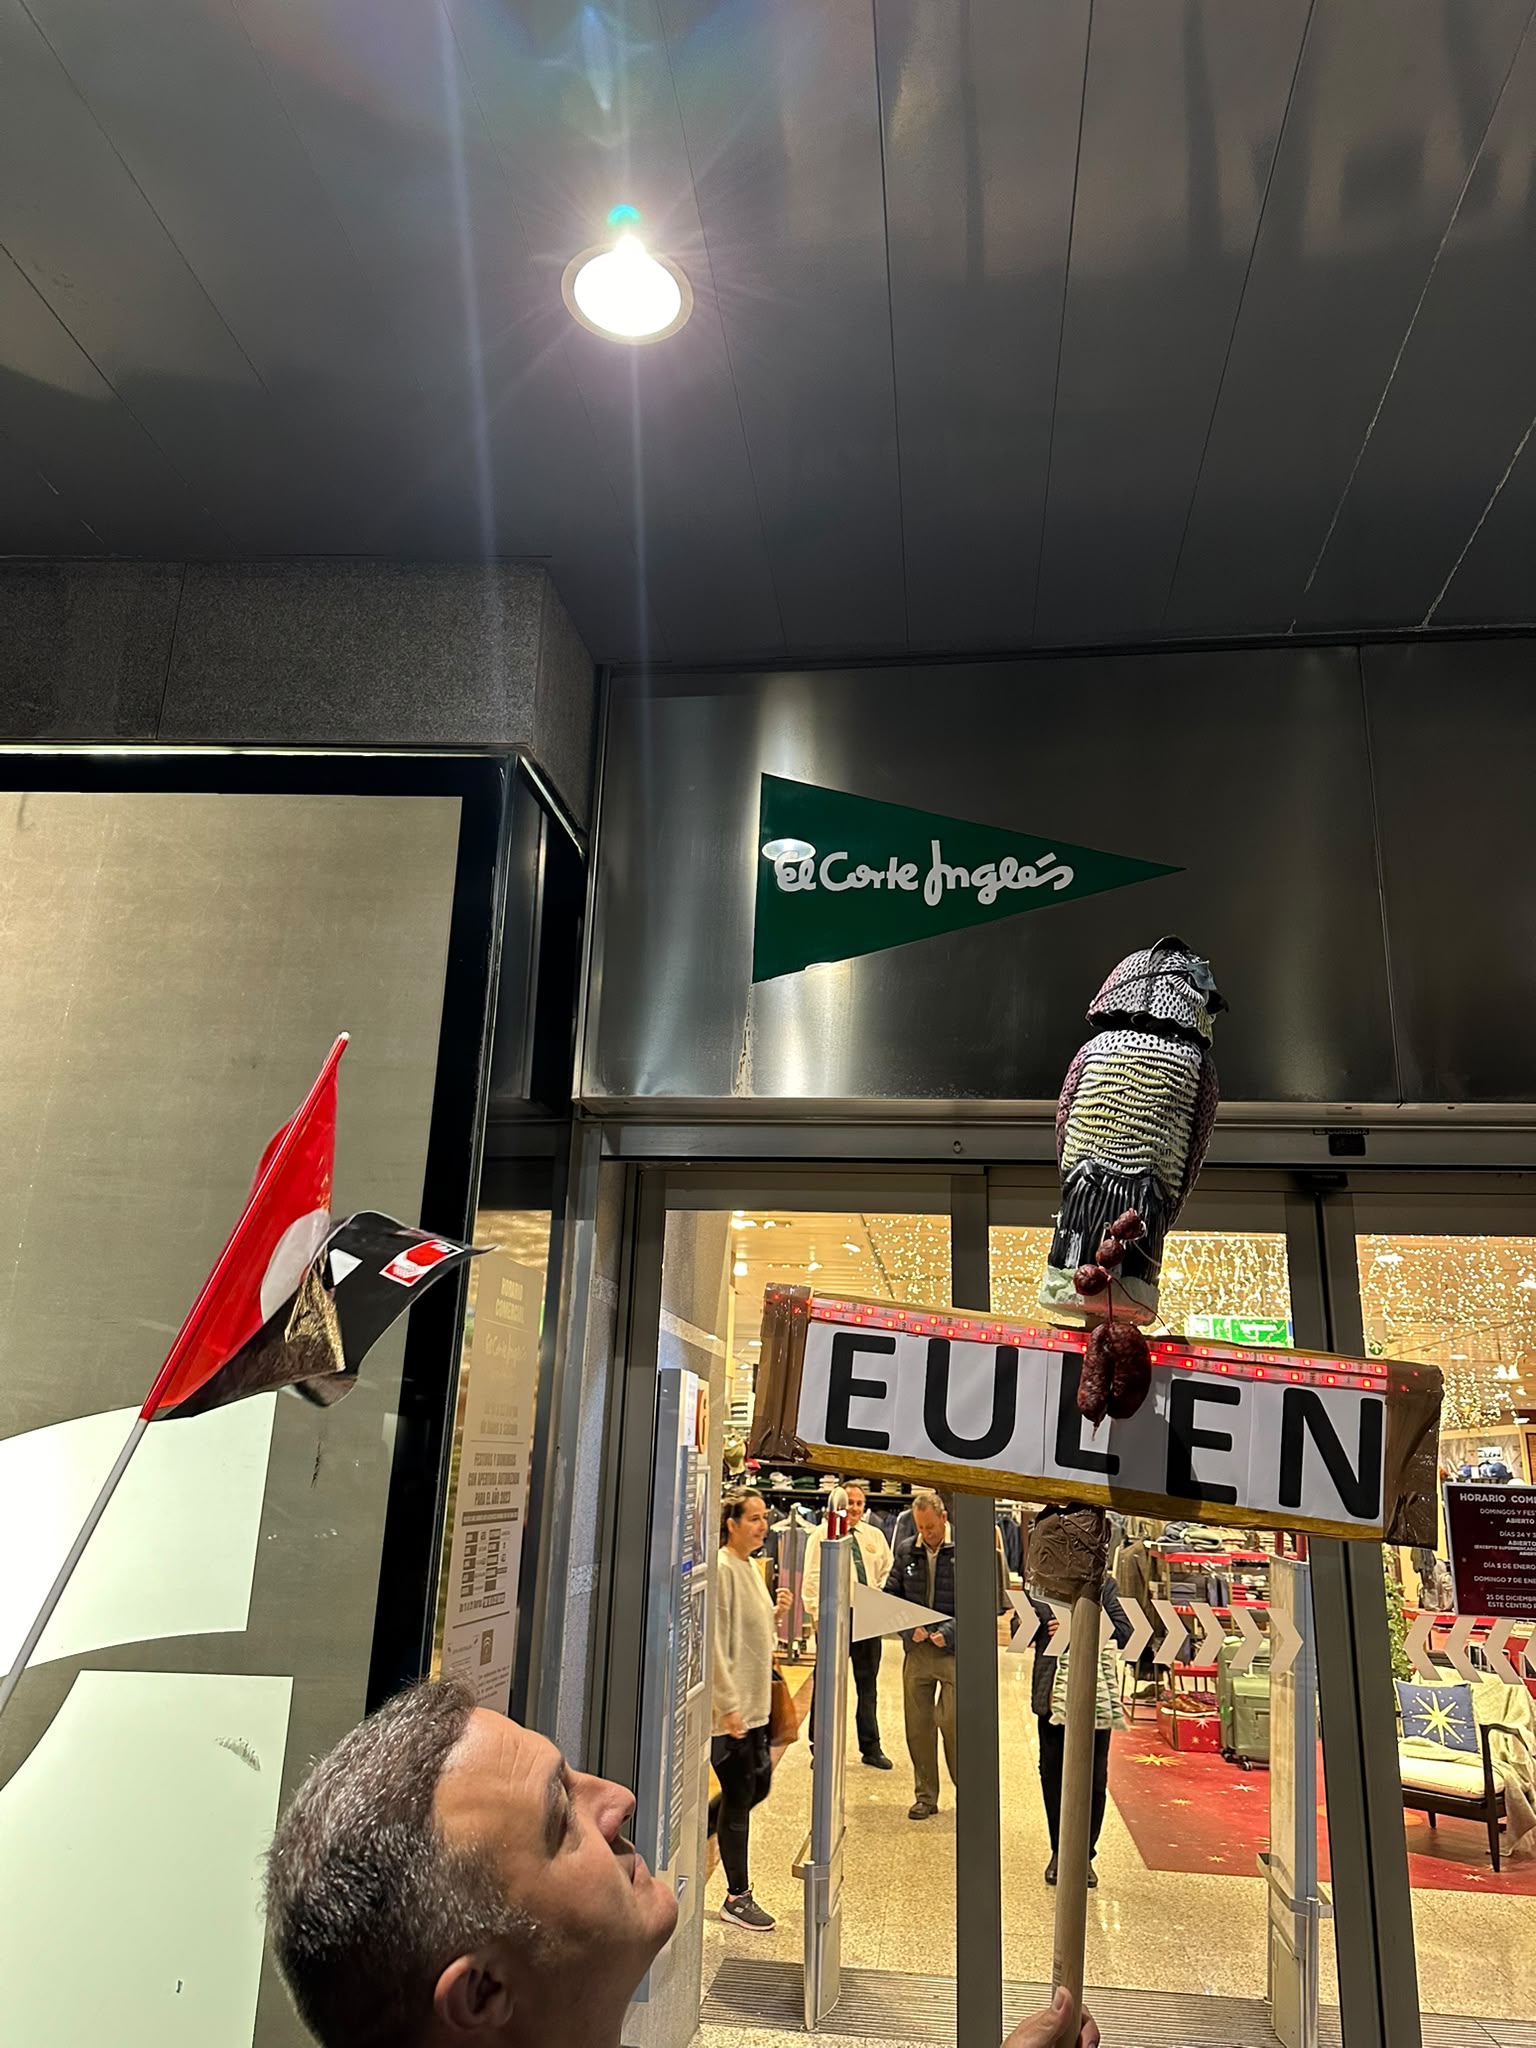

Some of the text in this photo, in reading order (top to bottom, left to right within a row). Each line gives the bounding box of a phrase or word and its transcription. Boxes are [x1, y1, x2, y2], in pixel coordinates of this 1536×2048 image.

[774, 839, 1075, 906] El Corte Inglés
[824, 1331, 1386, 1520] EULEN
[1460, 1493, 1506, 1502] HORARIO
[1500, 1530, 1515, 1538] DÍAS
[1483, 1561, 1496, 1569] DÍA
